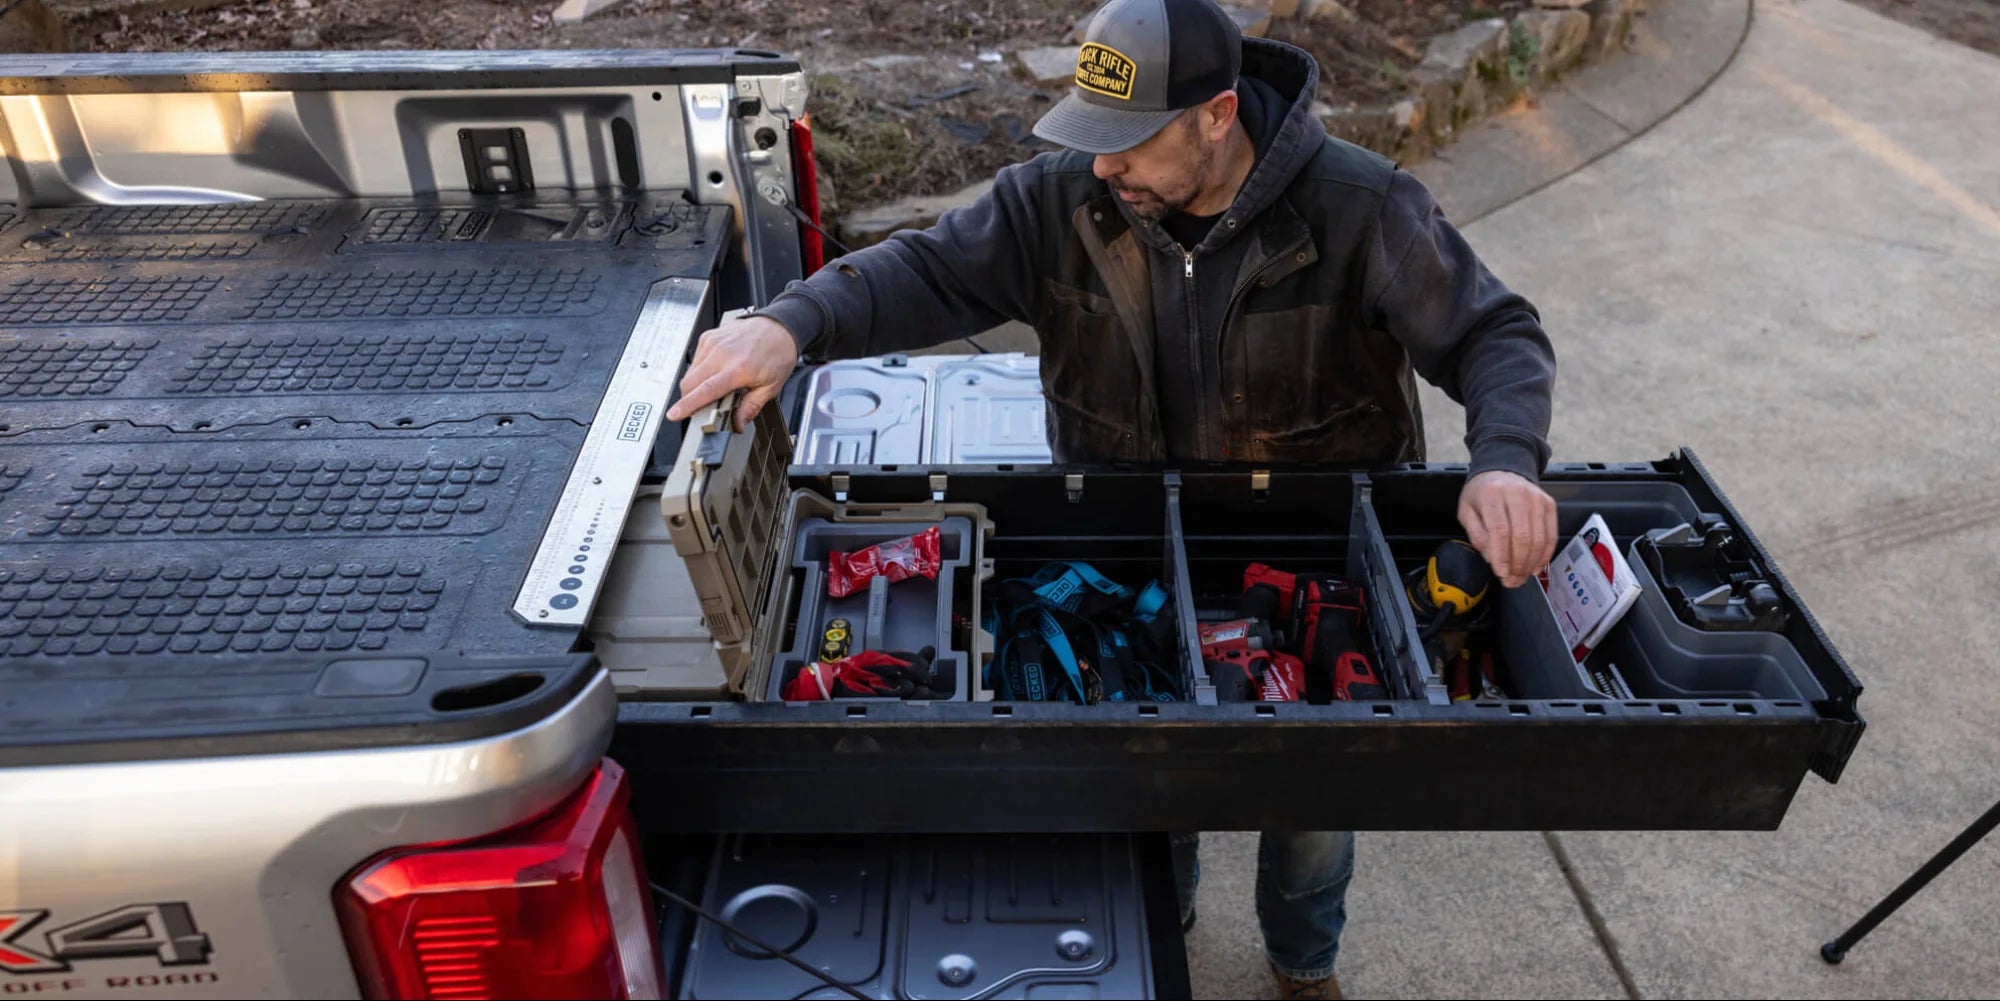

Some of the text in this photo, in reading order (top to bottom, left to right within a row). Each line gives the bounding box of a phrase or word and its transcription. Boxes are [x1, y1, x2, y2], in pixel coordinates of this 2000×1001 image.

[1081, 48, 1130, 80] LACK RIFLE
[1089, 73, 1127, 92] COMPANY
[623, 404, 647, 438] DECKED
[1027, 665, 1042, 702] ECKED
[3, 971, 220, 994] OFF ROAD
